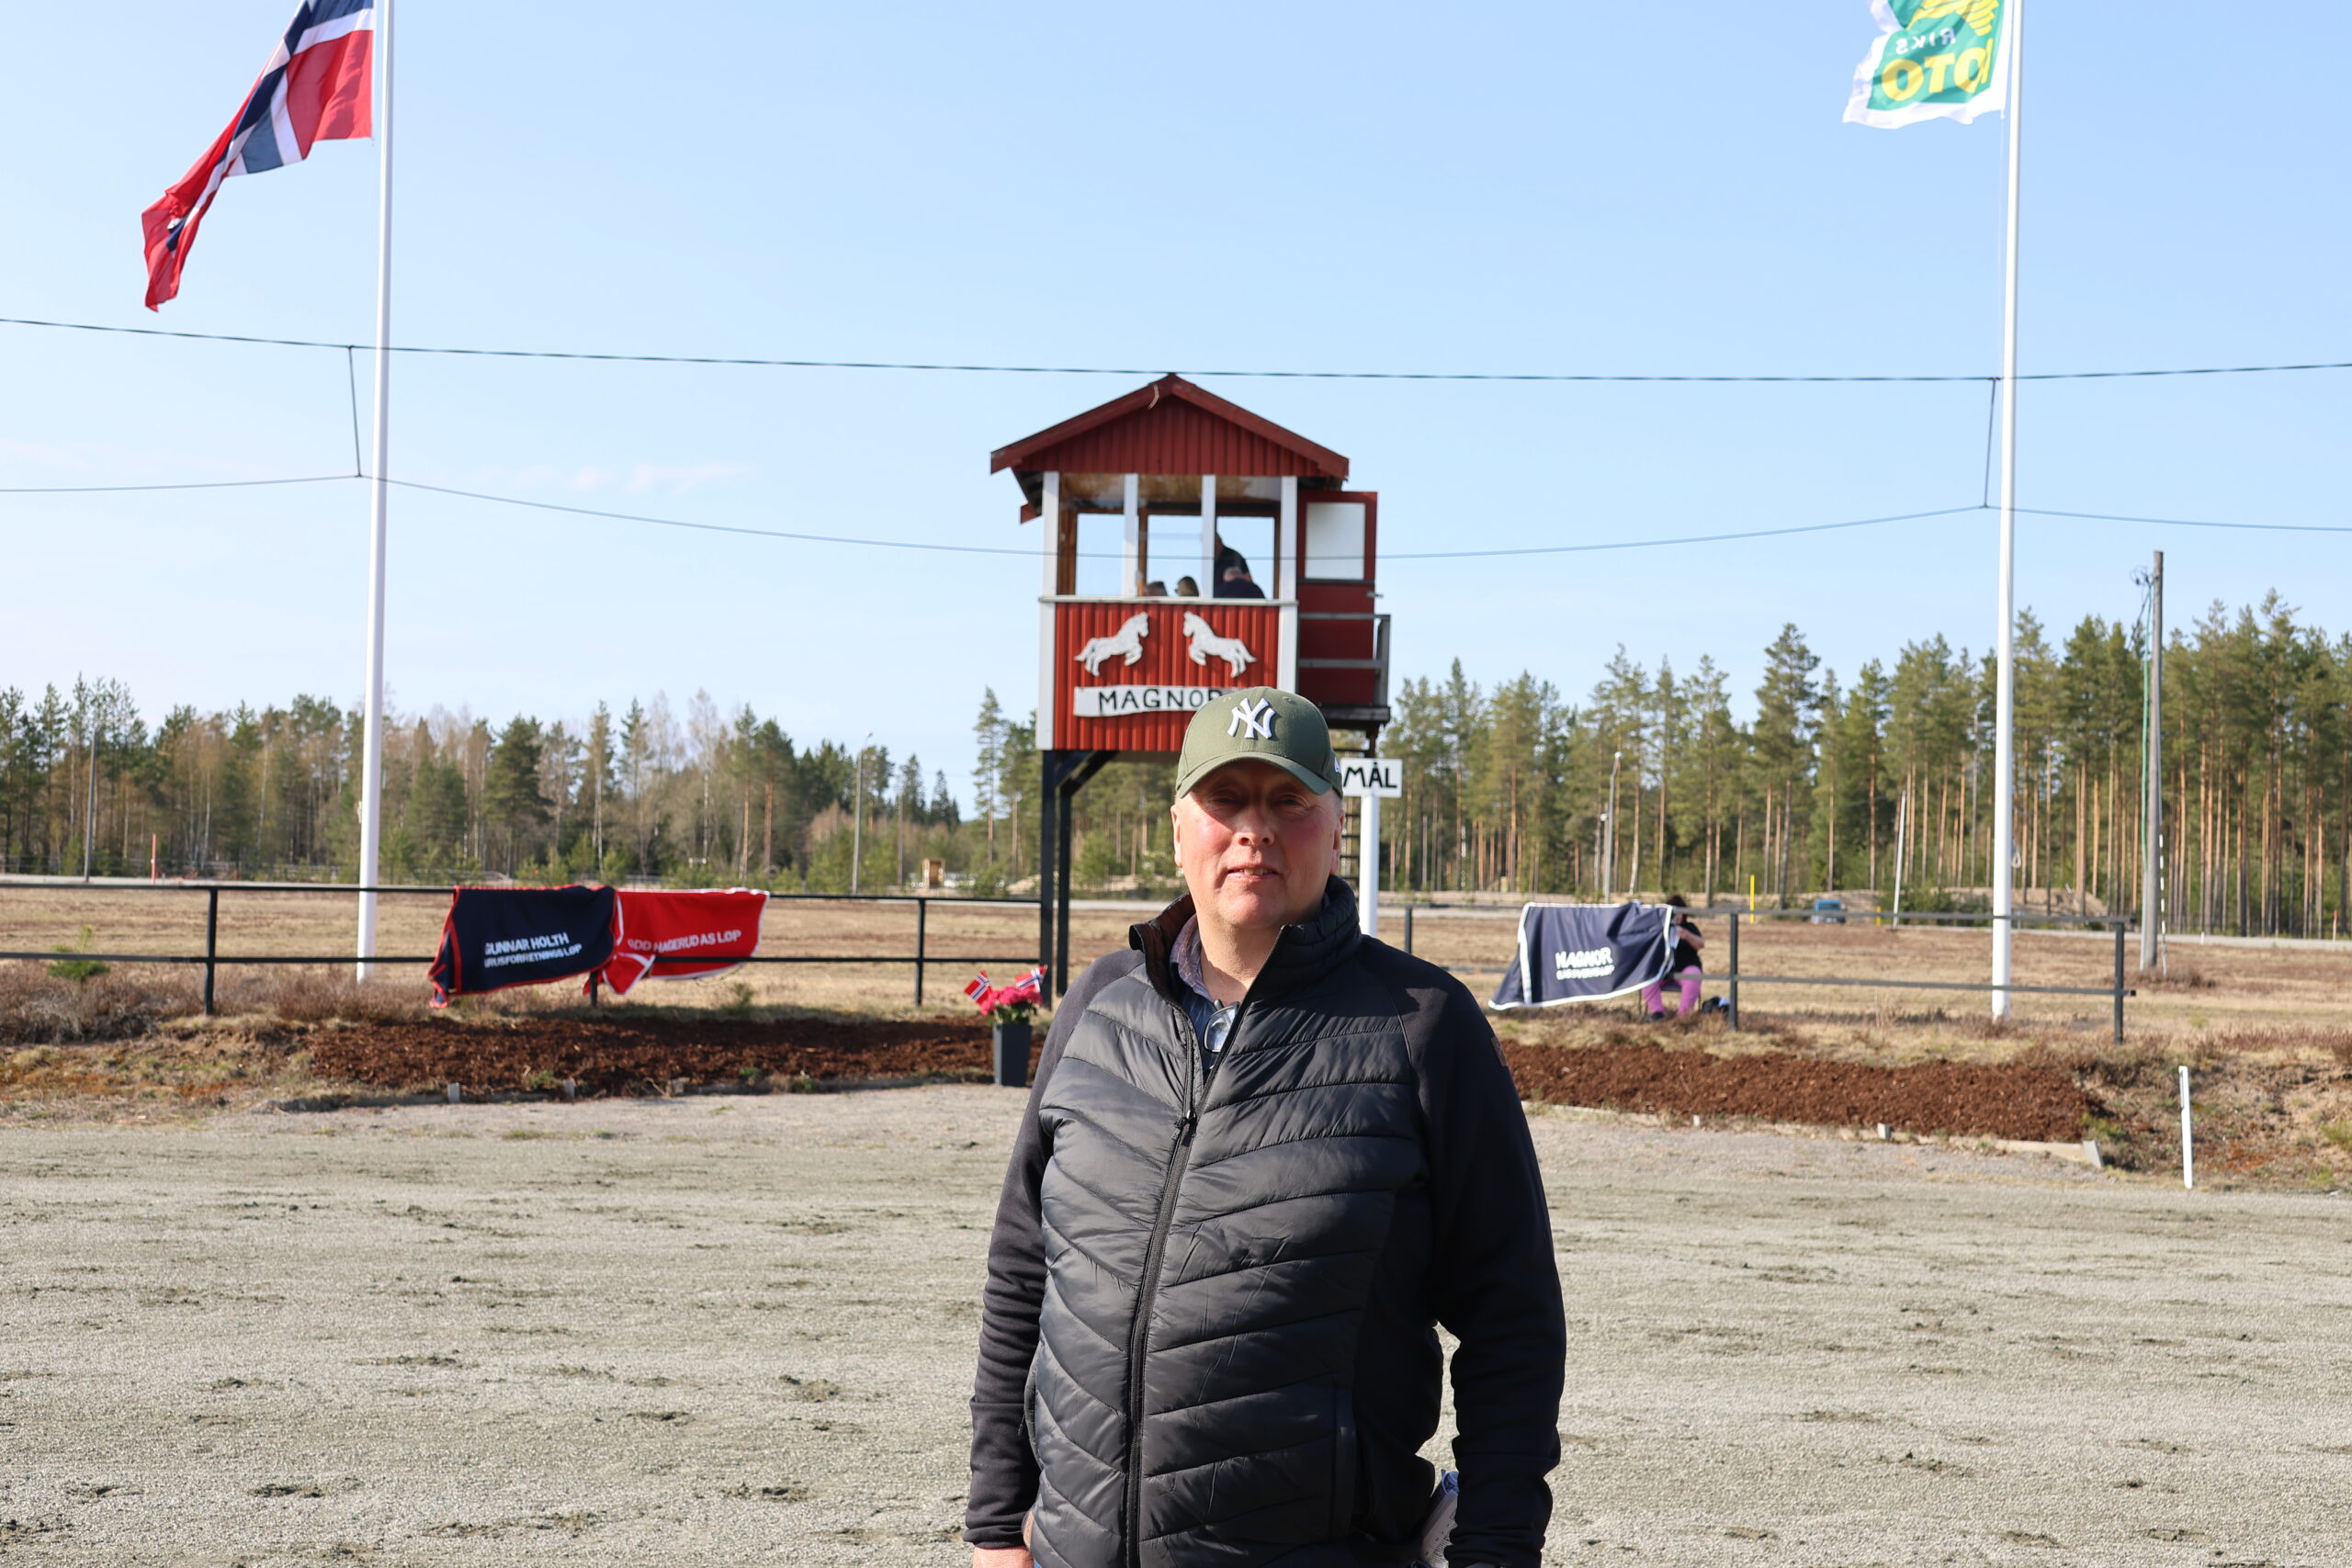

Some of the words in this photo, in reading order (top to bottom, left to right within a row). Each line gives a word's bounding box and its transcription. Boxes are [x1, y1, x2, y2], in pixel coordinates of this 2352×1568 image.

[1227, 697, 1276, 739] NY
[1343, 761, 1397, 788] MÅL
[530, 931, 571, 951] HOLTH
[700, 932, 717, 946] AS
[717, 930, 742, 944] LØP
[563, 942, 583, 957] LØP
